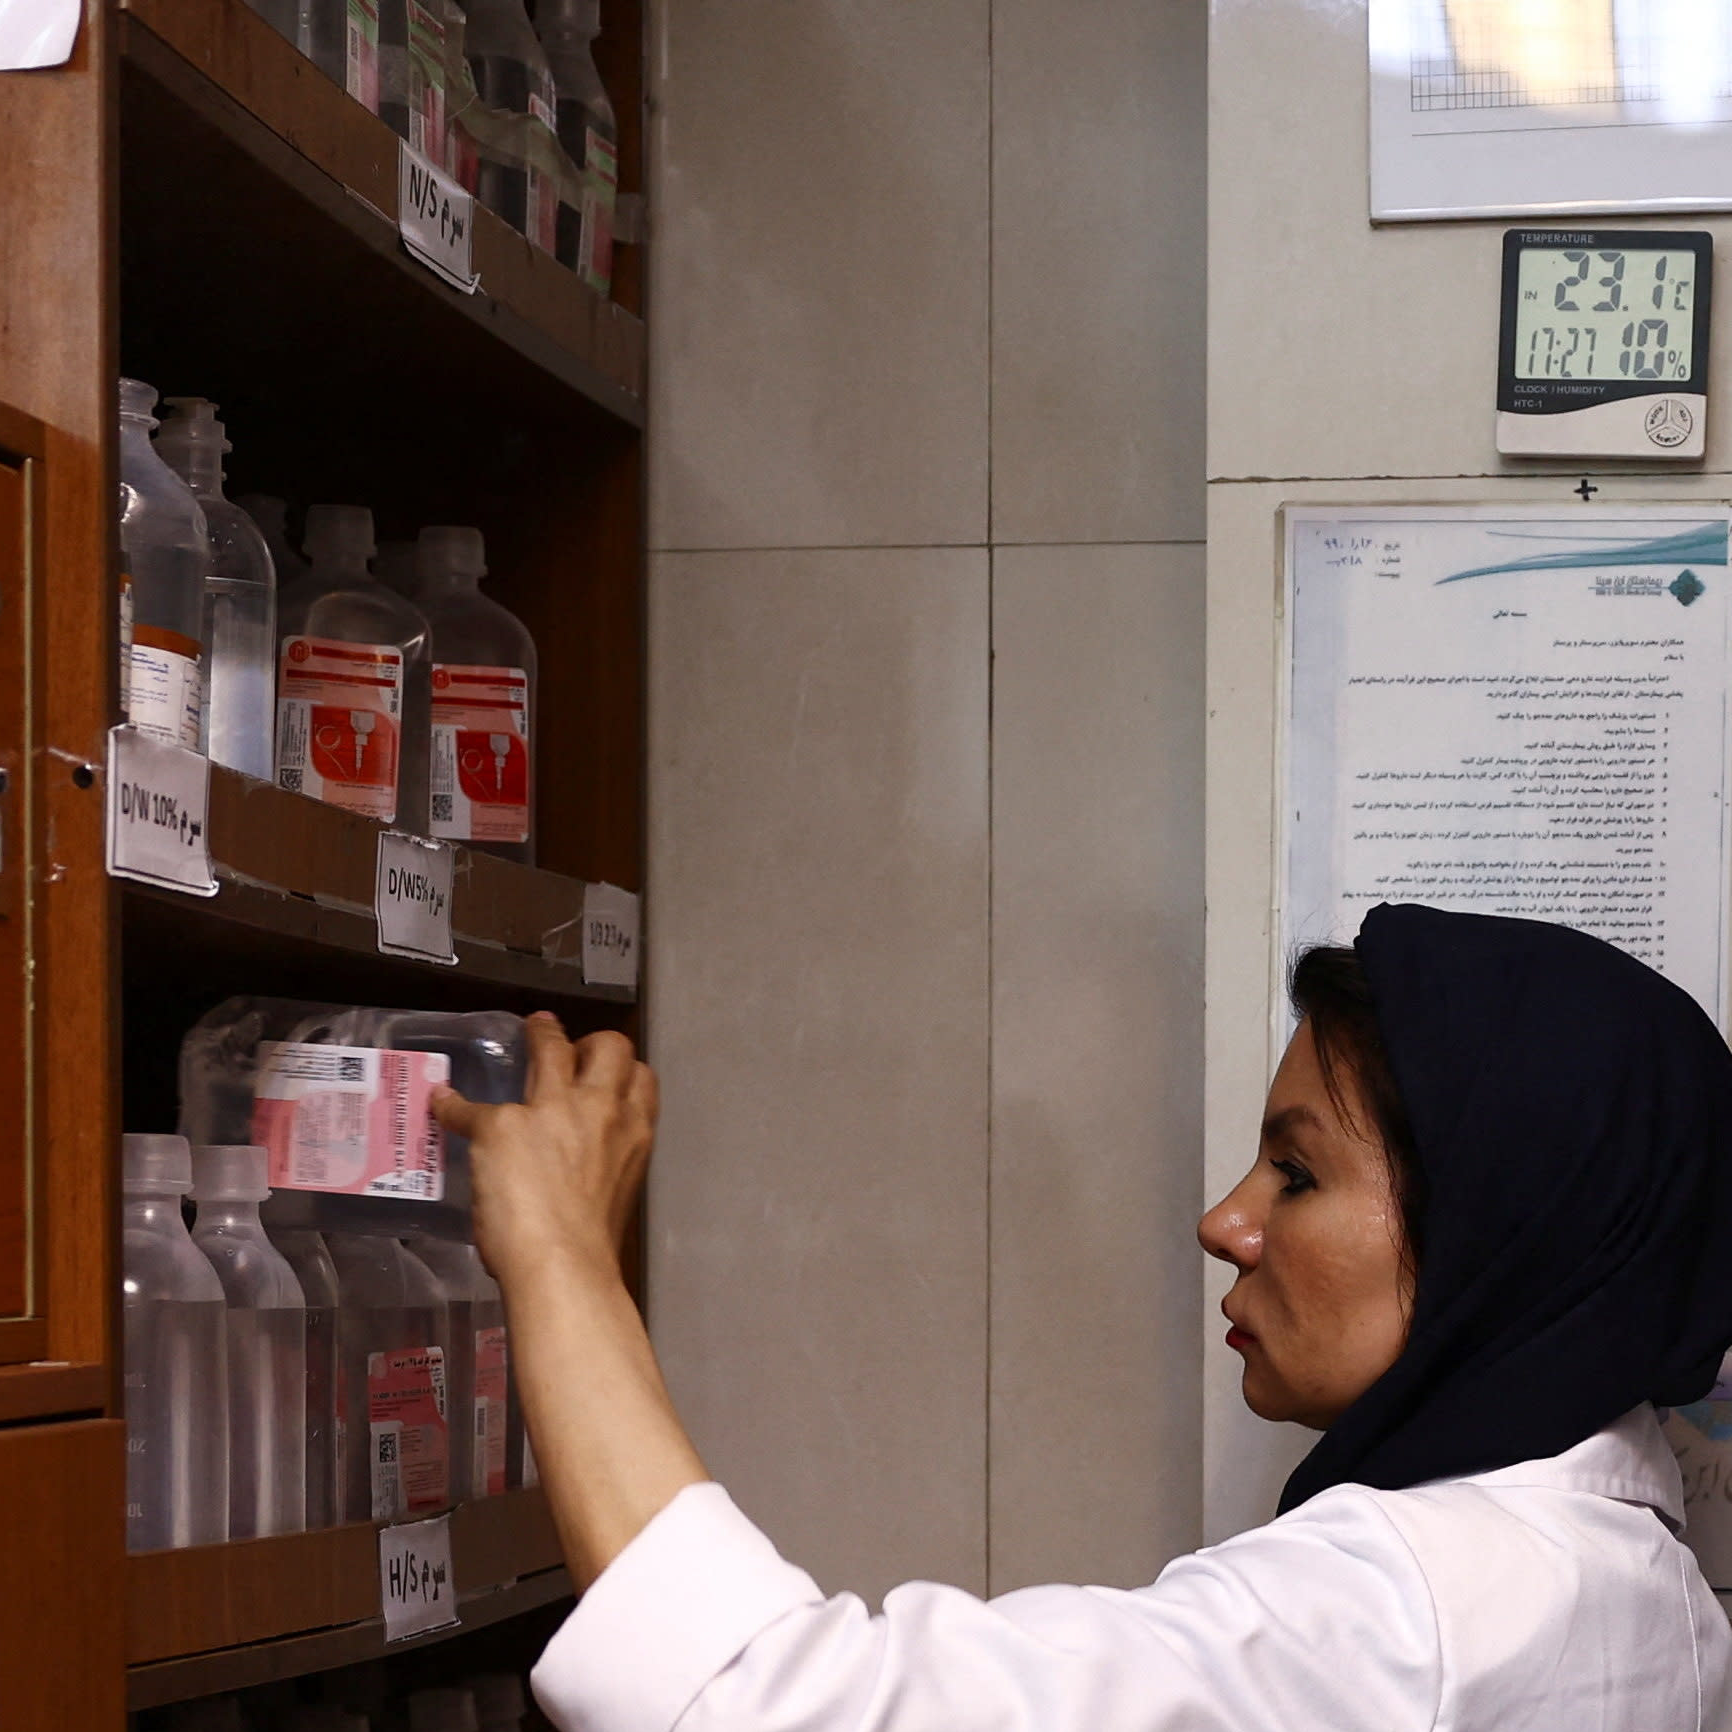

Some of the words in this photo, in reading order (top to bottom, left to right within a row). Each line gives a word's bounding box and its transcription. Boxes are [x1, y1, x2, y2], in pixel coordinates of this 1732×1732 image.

[409, 163, 438, 220] N/S
[1519, 233, 1595, 244] TEMPERATURE
[1524, 290, 1538, 301] IN
[1528, 327, 1597, 378] 17:27
[1513, 384, 1548, 394] CLOCK
[1556, 385, 1606, 395] HUMIDITY
[1513, 400, 1543, 409] HTC-1
[121, 782, 150, 824] D/W
[153, 793, 178, 831] 10%
[389, 1550, 419, 1604] H/S
